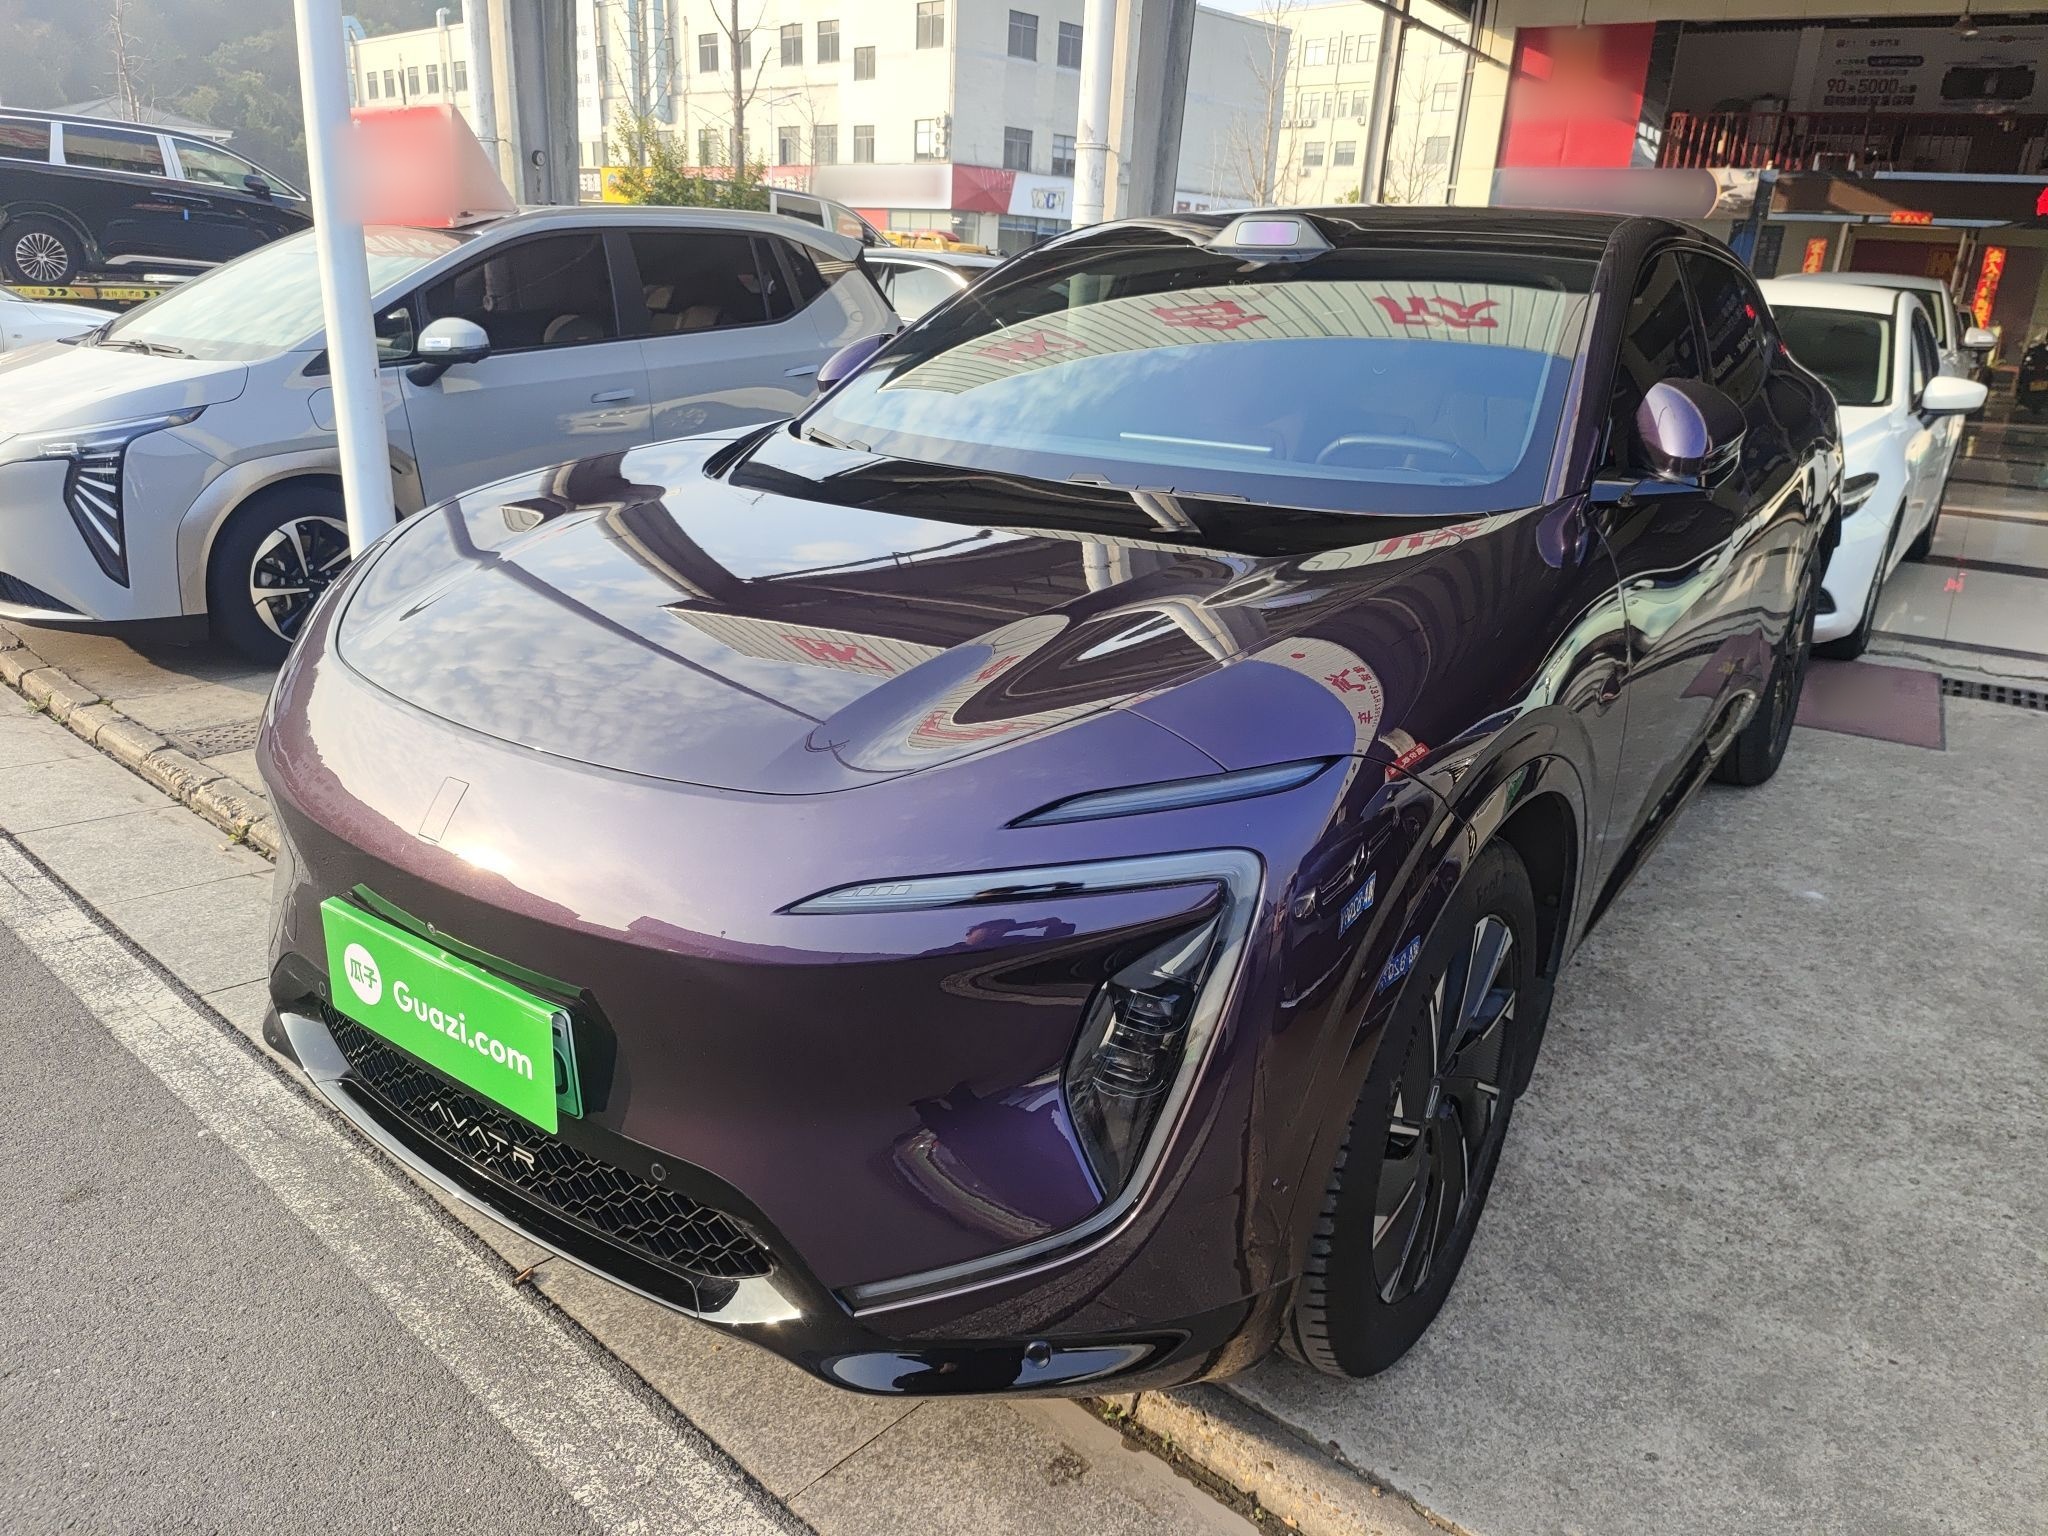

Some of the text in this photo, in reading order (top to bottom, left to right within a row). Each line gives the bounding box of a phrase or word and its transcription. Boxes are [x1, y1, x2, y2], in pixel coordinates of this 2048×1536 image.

[349, 957, 378, 990] 瓜子
[392, 980, 534, 1081] Guazi.com
[429, 1101, 536, 1172] AVATR
